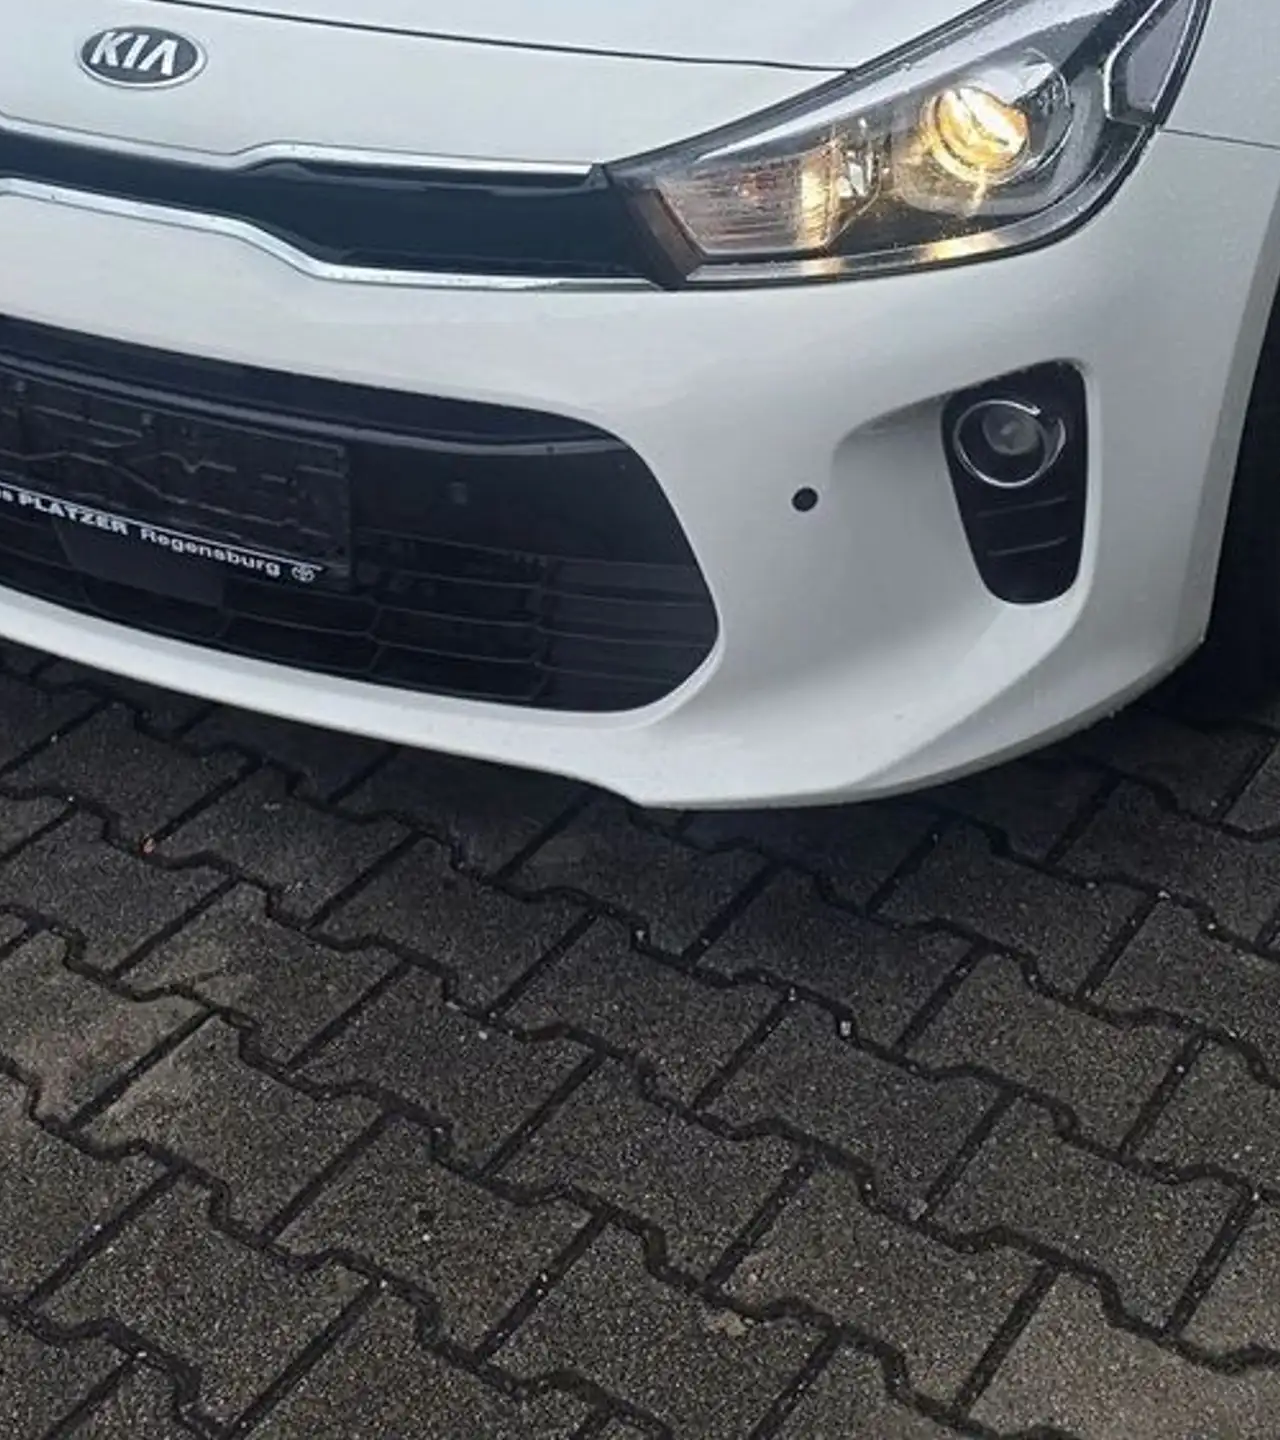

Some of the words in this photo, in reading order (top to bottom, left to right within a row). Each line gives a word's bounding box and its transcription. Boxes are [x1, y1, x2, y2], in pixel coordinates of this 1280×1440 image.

[89, 31, 178, 76] KIA
[19, 490, 128, 536] PLATZER
[140, 527, 281, 578] Regensburg
